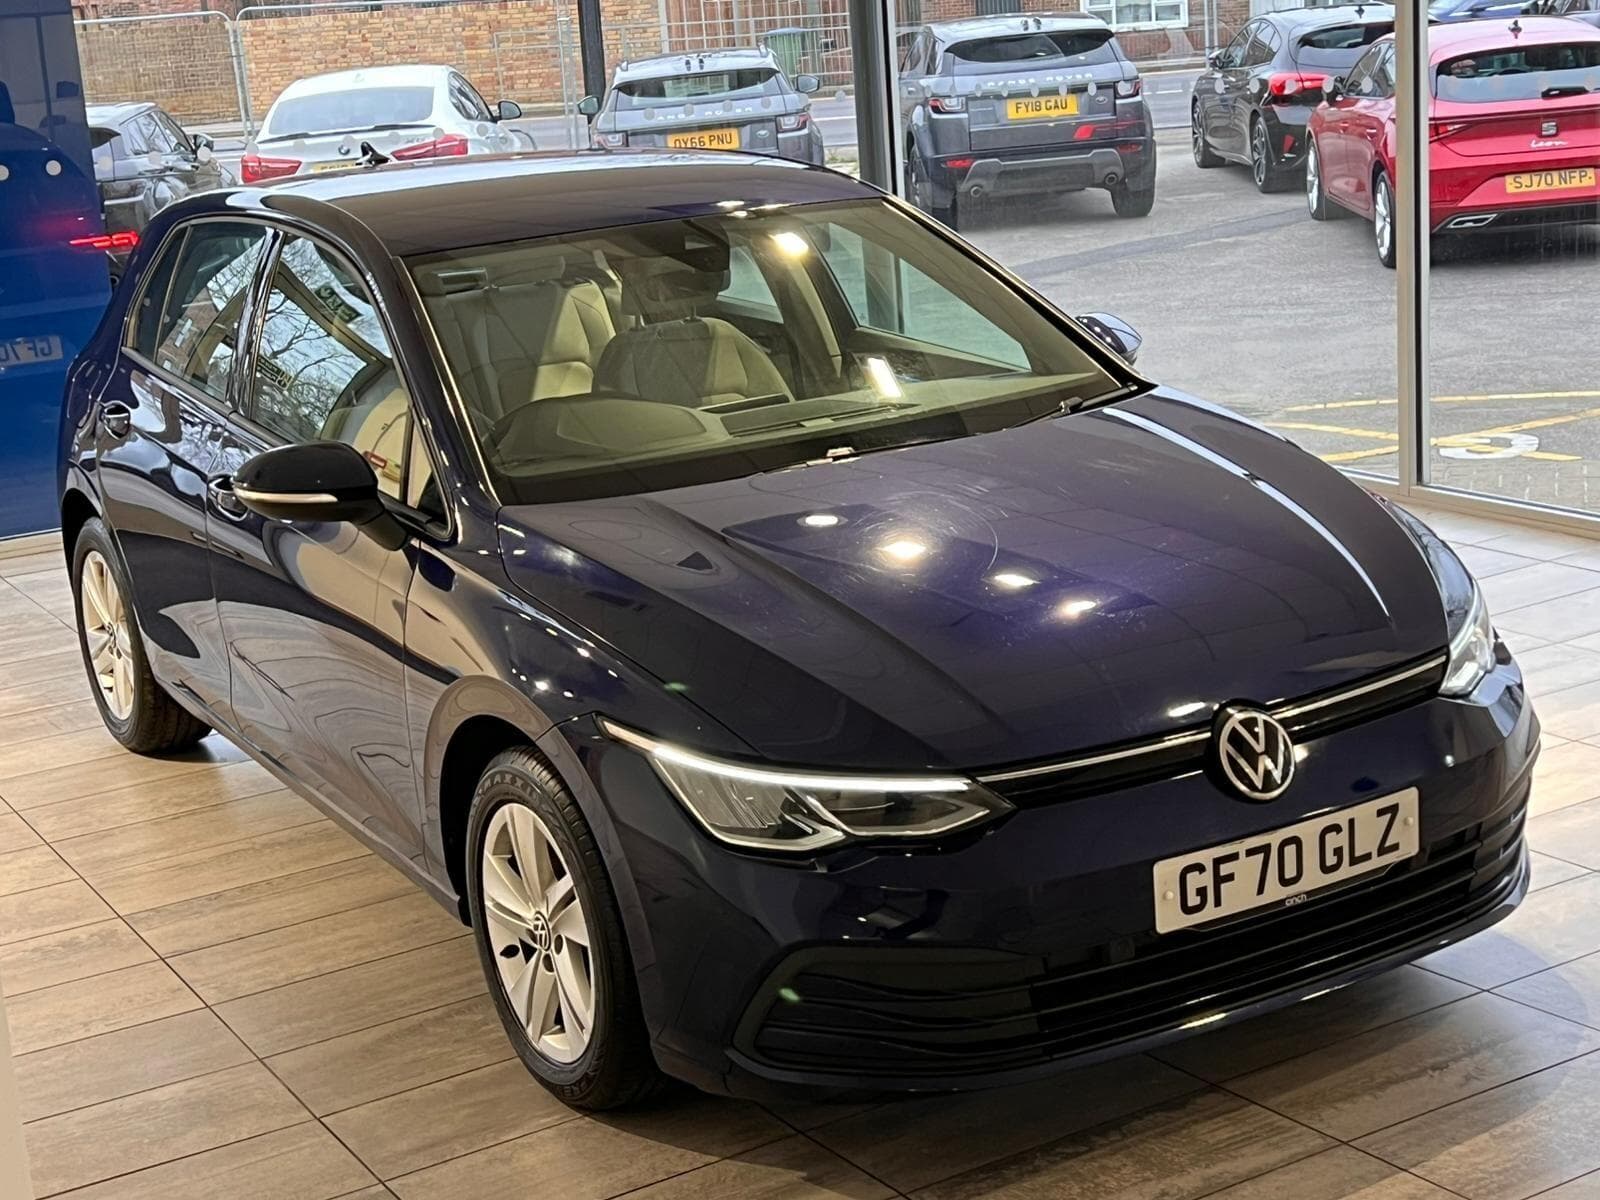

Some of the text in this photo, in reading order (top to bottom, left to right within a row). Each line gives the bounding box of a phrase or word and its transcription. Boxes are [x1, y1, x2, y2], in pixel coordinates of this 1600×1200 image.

[1015, 97, 1068, 115] FY18 GAU
[708, 132, 732, 146] PNU
[1512, 169, 1588, 190] SJ70 NFP
[1179, 802, 1400, 916] GF70 GLZ
[1285, 893, 1307, 907] cinch
